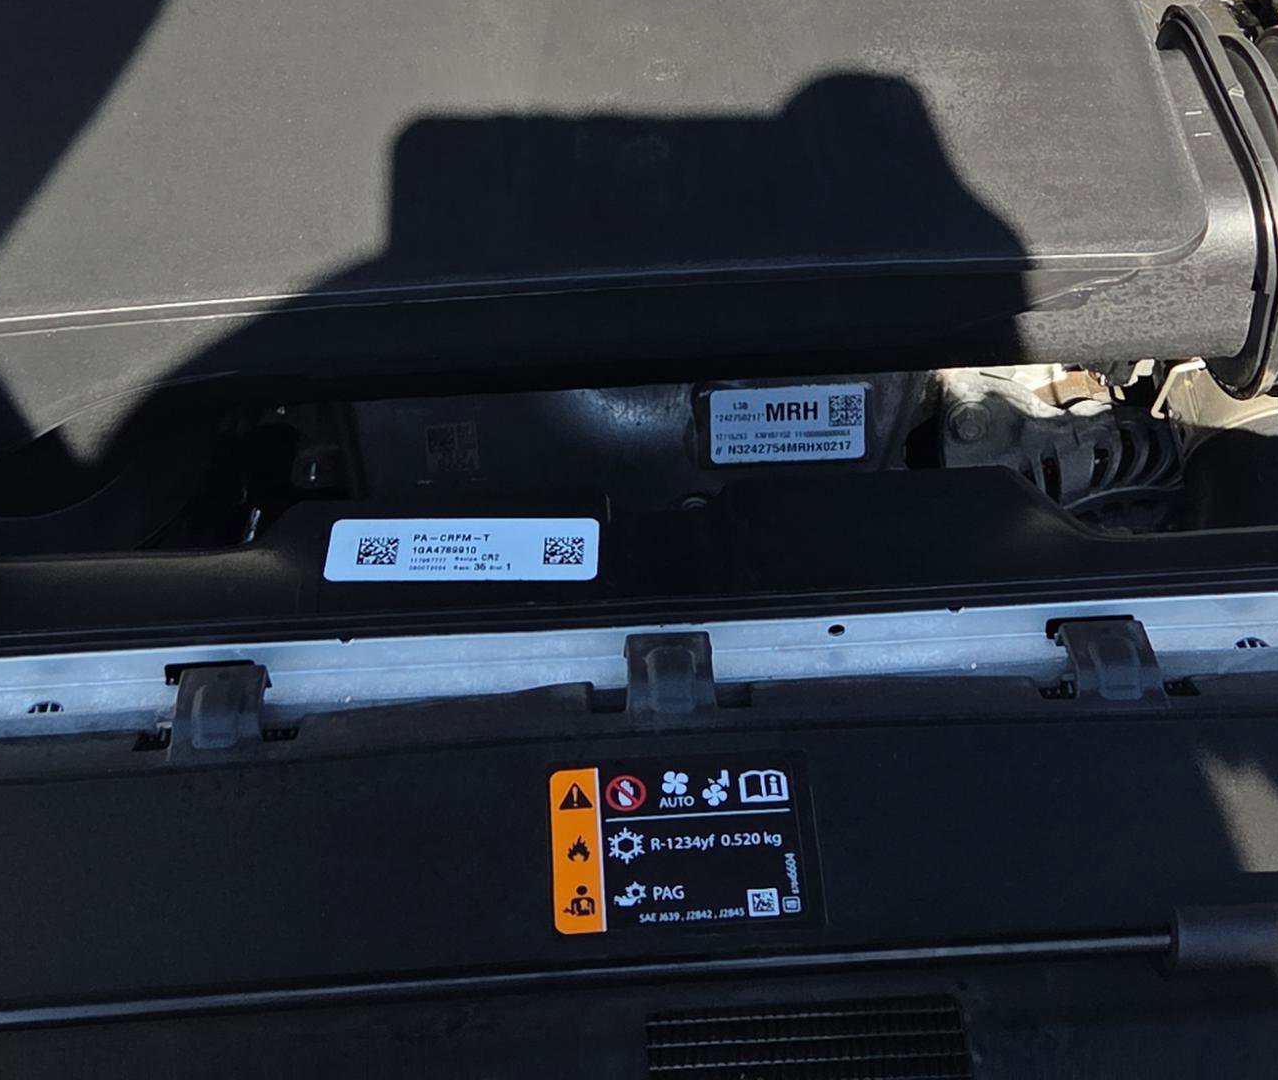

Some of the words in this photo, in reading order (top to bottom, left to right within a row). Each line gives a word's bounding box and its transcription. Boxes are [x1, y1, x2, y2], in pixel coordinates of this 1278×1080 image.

[765, 401, 818, 422] MRH
[506, 562, 512, 571] 1
[659, 795, 696, 809] AUTO
[650, 833, 716, 851] R-1234yf
[721, 832, 761, 847] 0.520
[763, 830, 783, 847] kg
[653, 884, 686, 900] PAG
[639, 913, 657, 923] SAE
